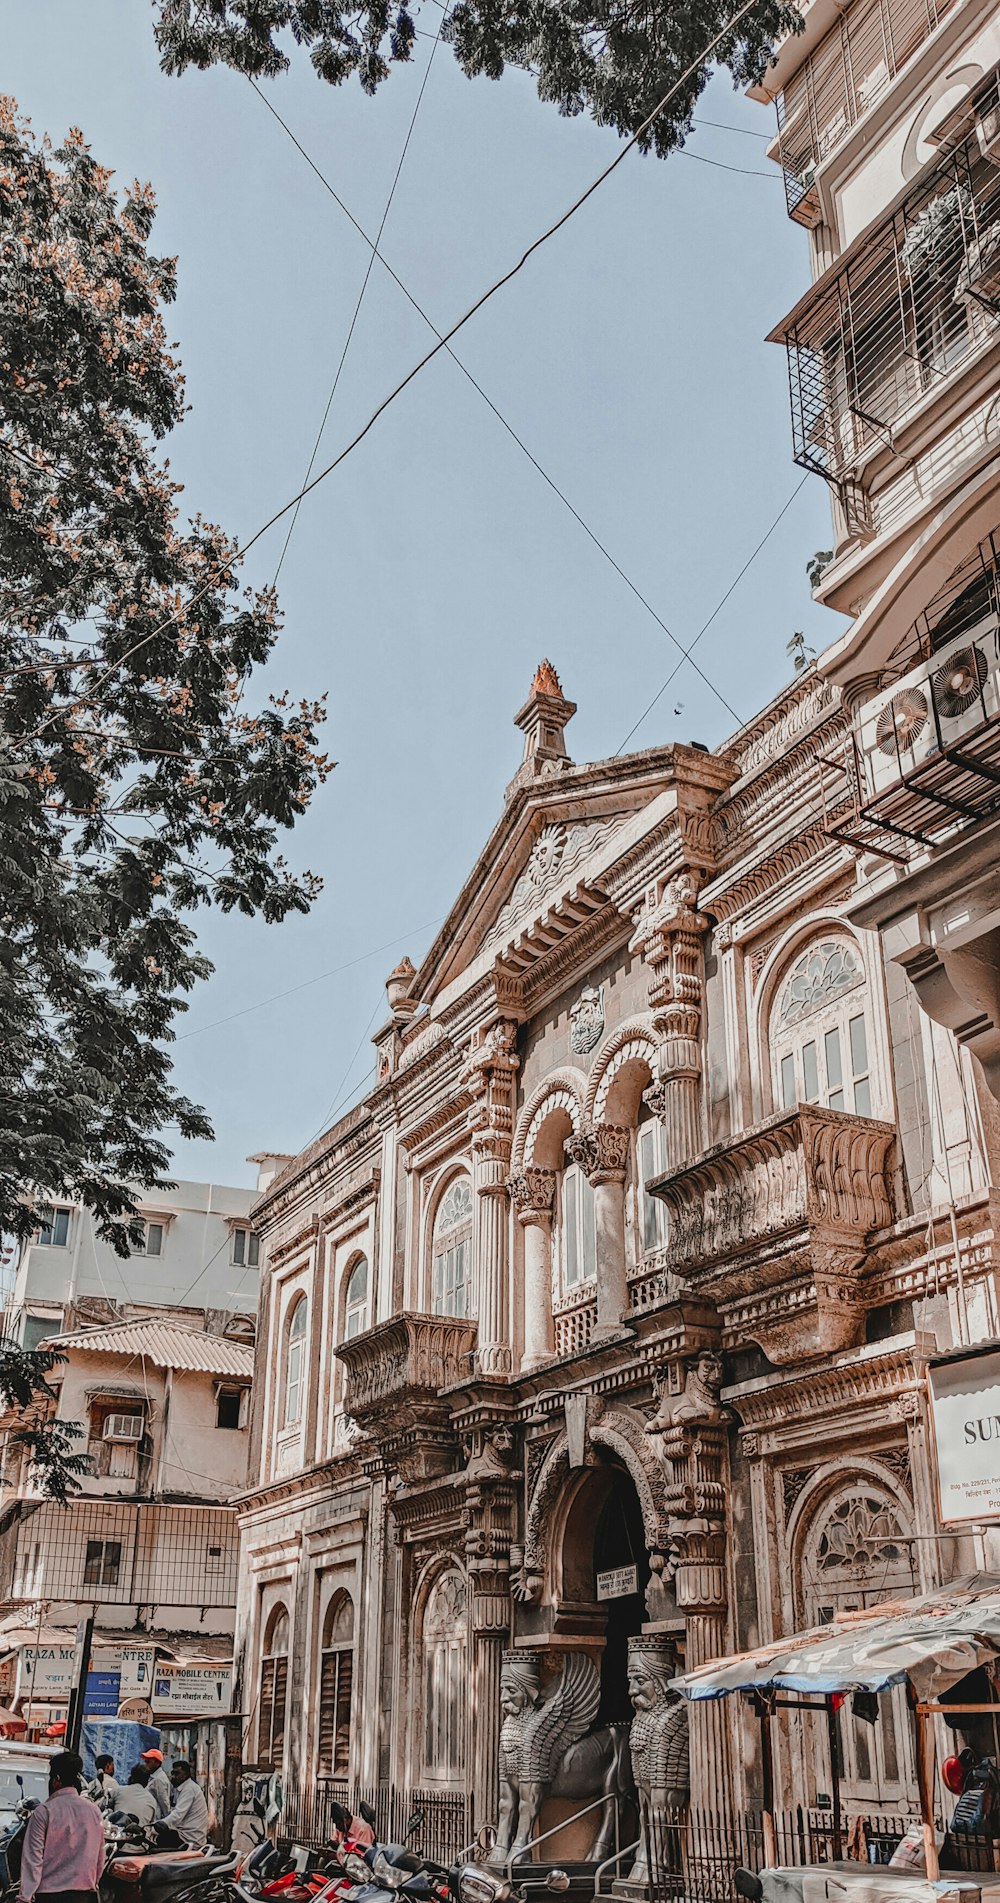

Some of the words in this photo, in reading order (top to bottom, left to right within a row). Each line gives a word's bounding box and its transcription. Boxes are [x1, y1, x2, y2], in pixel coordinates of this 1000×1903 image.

[25, 1649, 55, 1659] RAZA
[122, 1651, 152, 1661] NTRE
[156, 1668, 174, 1677] RAZA
[175, 1669, 202, 1678] MOBILE
[203, 1670, 231, 1679] CENTRE
